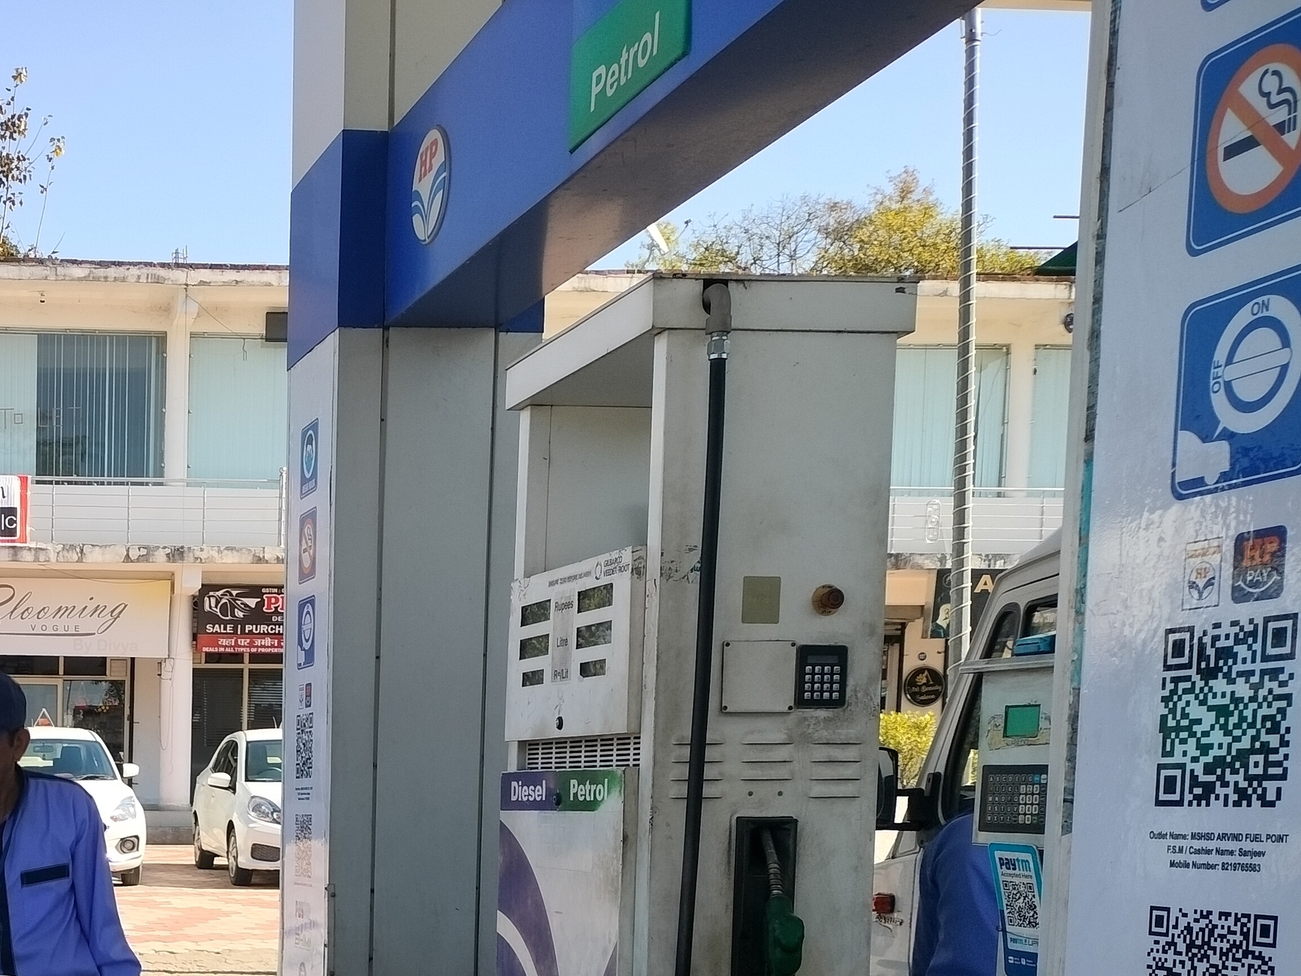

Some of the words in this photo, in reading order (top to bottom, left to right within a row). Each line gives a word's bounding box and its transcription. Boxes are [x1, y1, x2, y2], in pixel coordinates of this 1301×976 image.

[590, 11, 660, 113] Petrol
[417, 137, 439, 184] HP
[1250, 298, 1271, 317] ON
[1211, 360, 1224, 394] OFF
[1242, 536, 1280, 567] HP
[1194, 566, 1211, 580] HP
[1246, 567, 1272, 584] PAY
[554, 600, 573, 613] Rupees
[30, 624, 81, 633] VOGUE
[206, 624, 234, 633] SALE
[74, 639, 92, 654] By
[98, 639, 138, 654] Divya
[237, 638, 251, 646] पर
[252, 637, 278, 647] जमीन
[556, 637, 569, 648] Litre
[510, 780, 546, 801] Diesel
[570, 778, 608, 801] Petrol
[1149, 831, 1168, 841] Outlet
[1169, 831, 1189, 841] Name:
[1190, 832, 1215, 842] MSHSD
[1216, 832, 1243, 842] ARVIND
[1245, 833, 1264, 843] FUEL
[1266, 833, 1289, 843] POINT
[1189, 846, 1213, 856] Cashier
[1215, 847, 1237, 857] Name:
[1238, 848, 1267, 859] Sanjeev
[1169, 859, 1190, 869] Mobile
[1191, 860, 1219, 871] Number:
[1001, 871, 1021, 879] Accepted
